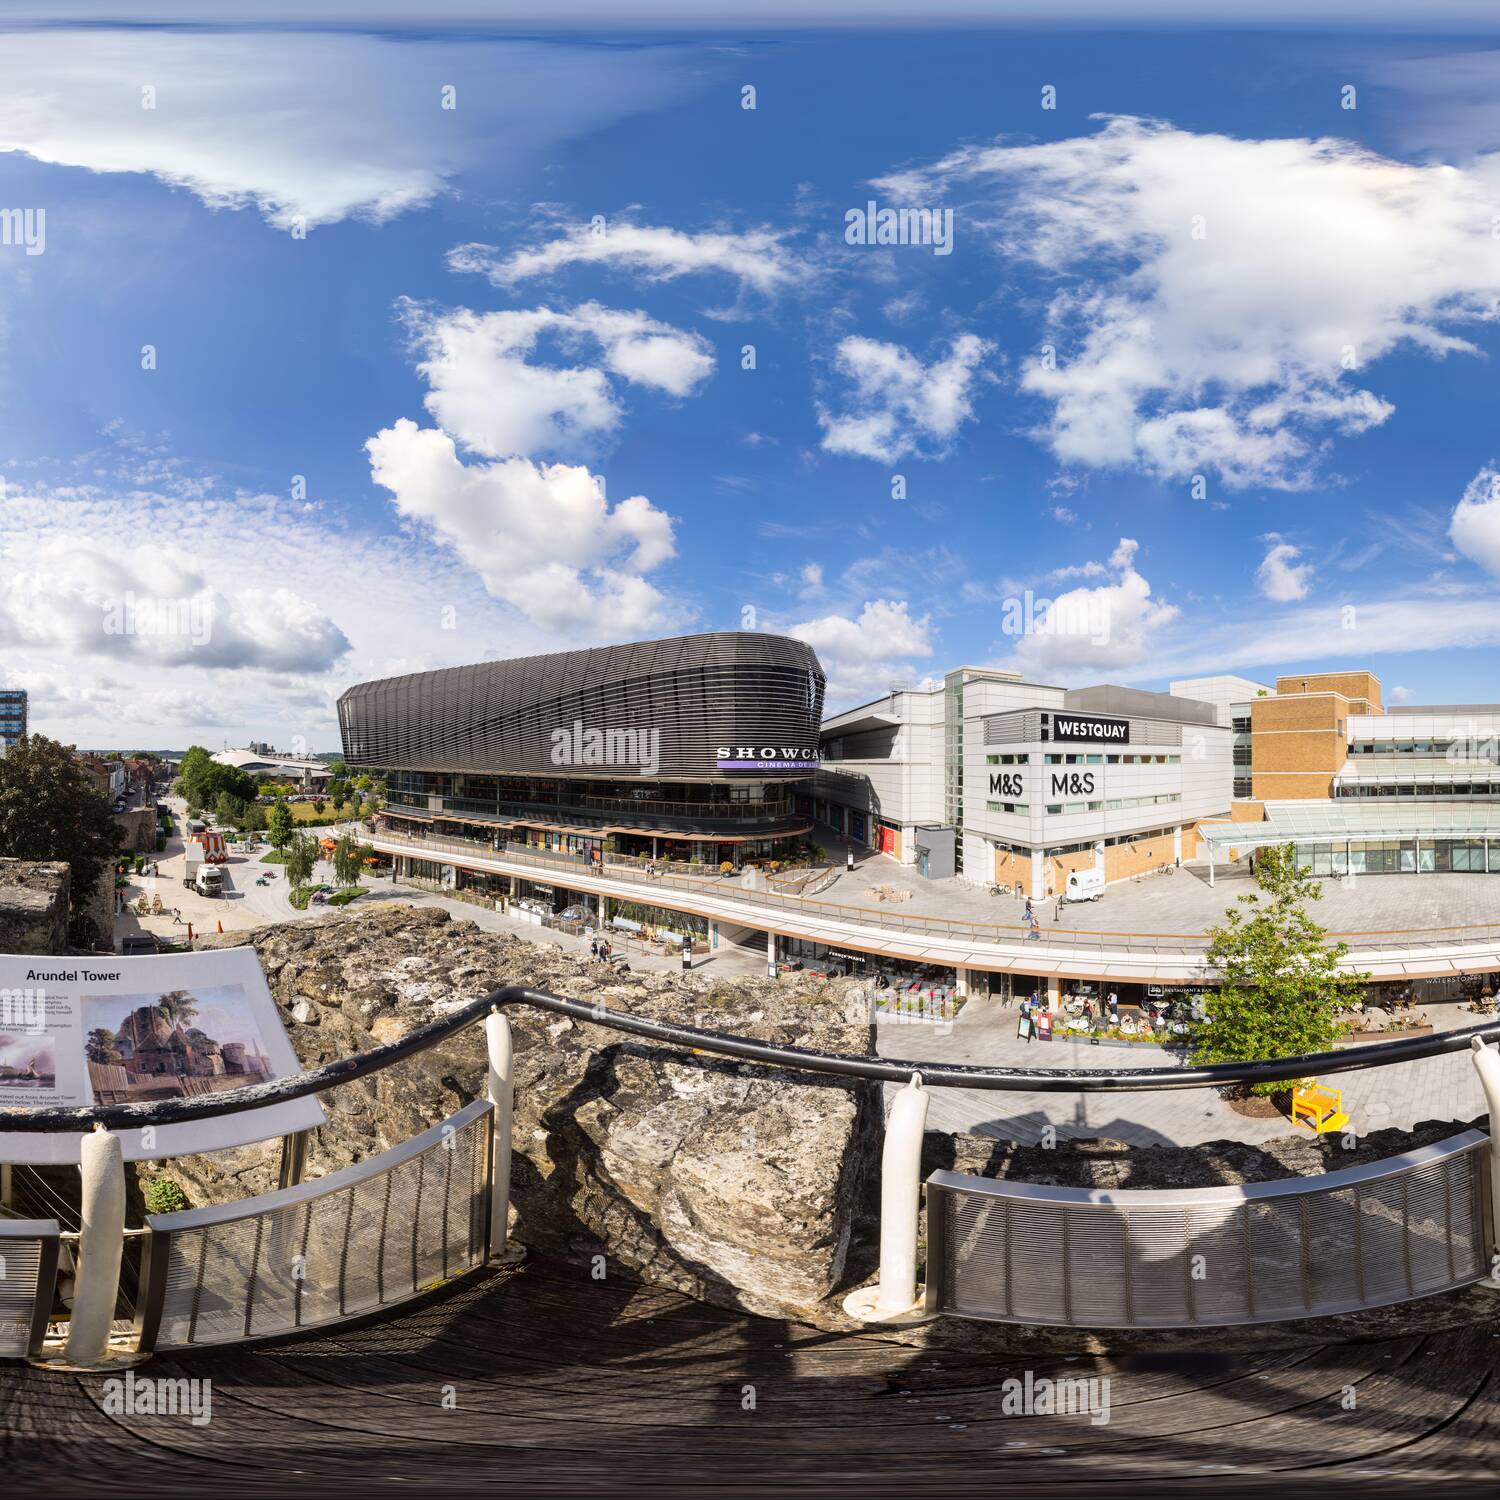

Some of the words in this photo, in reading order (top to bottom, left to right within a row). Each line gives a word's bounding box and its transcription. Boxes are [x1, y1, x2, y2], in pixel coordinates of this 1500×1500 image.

[1058, 721, 1126, 738] WESTQUAY
[717, 747, 824, 760] SHOWCA
[989, 773, 1023, 797] M&S
[1051, 772, 1095, 796] M&S
[26, 970, 78, 982] Arundel
[82, 970, 121, 982] Tower
